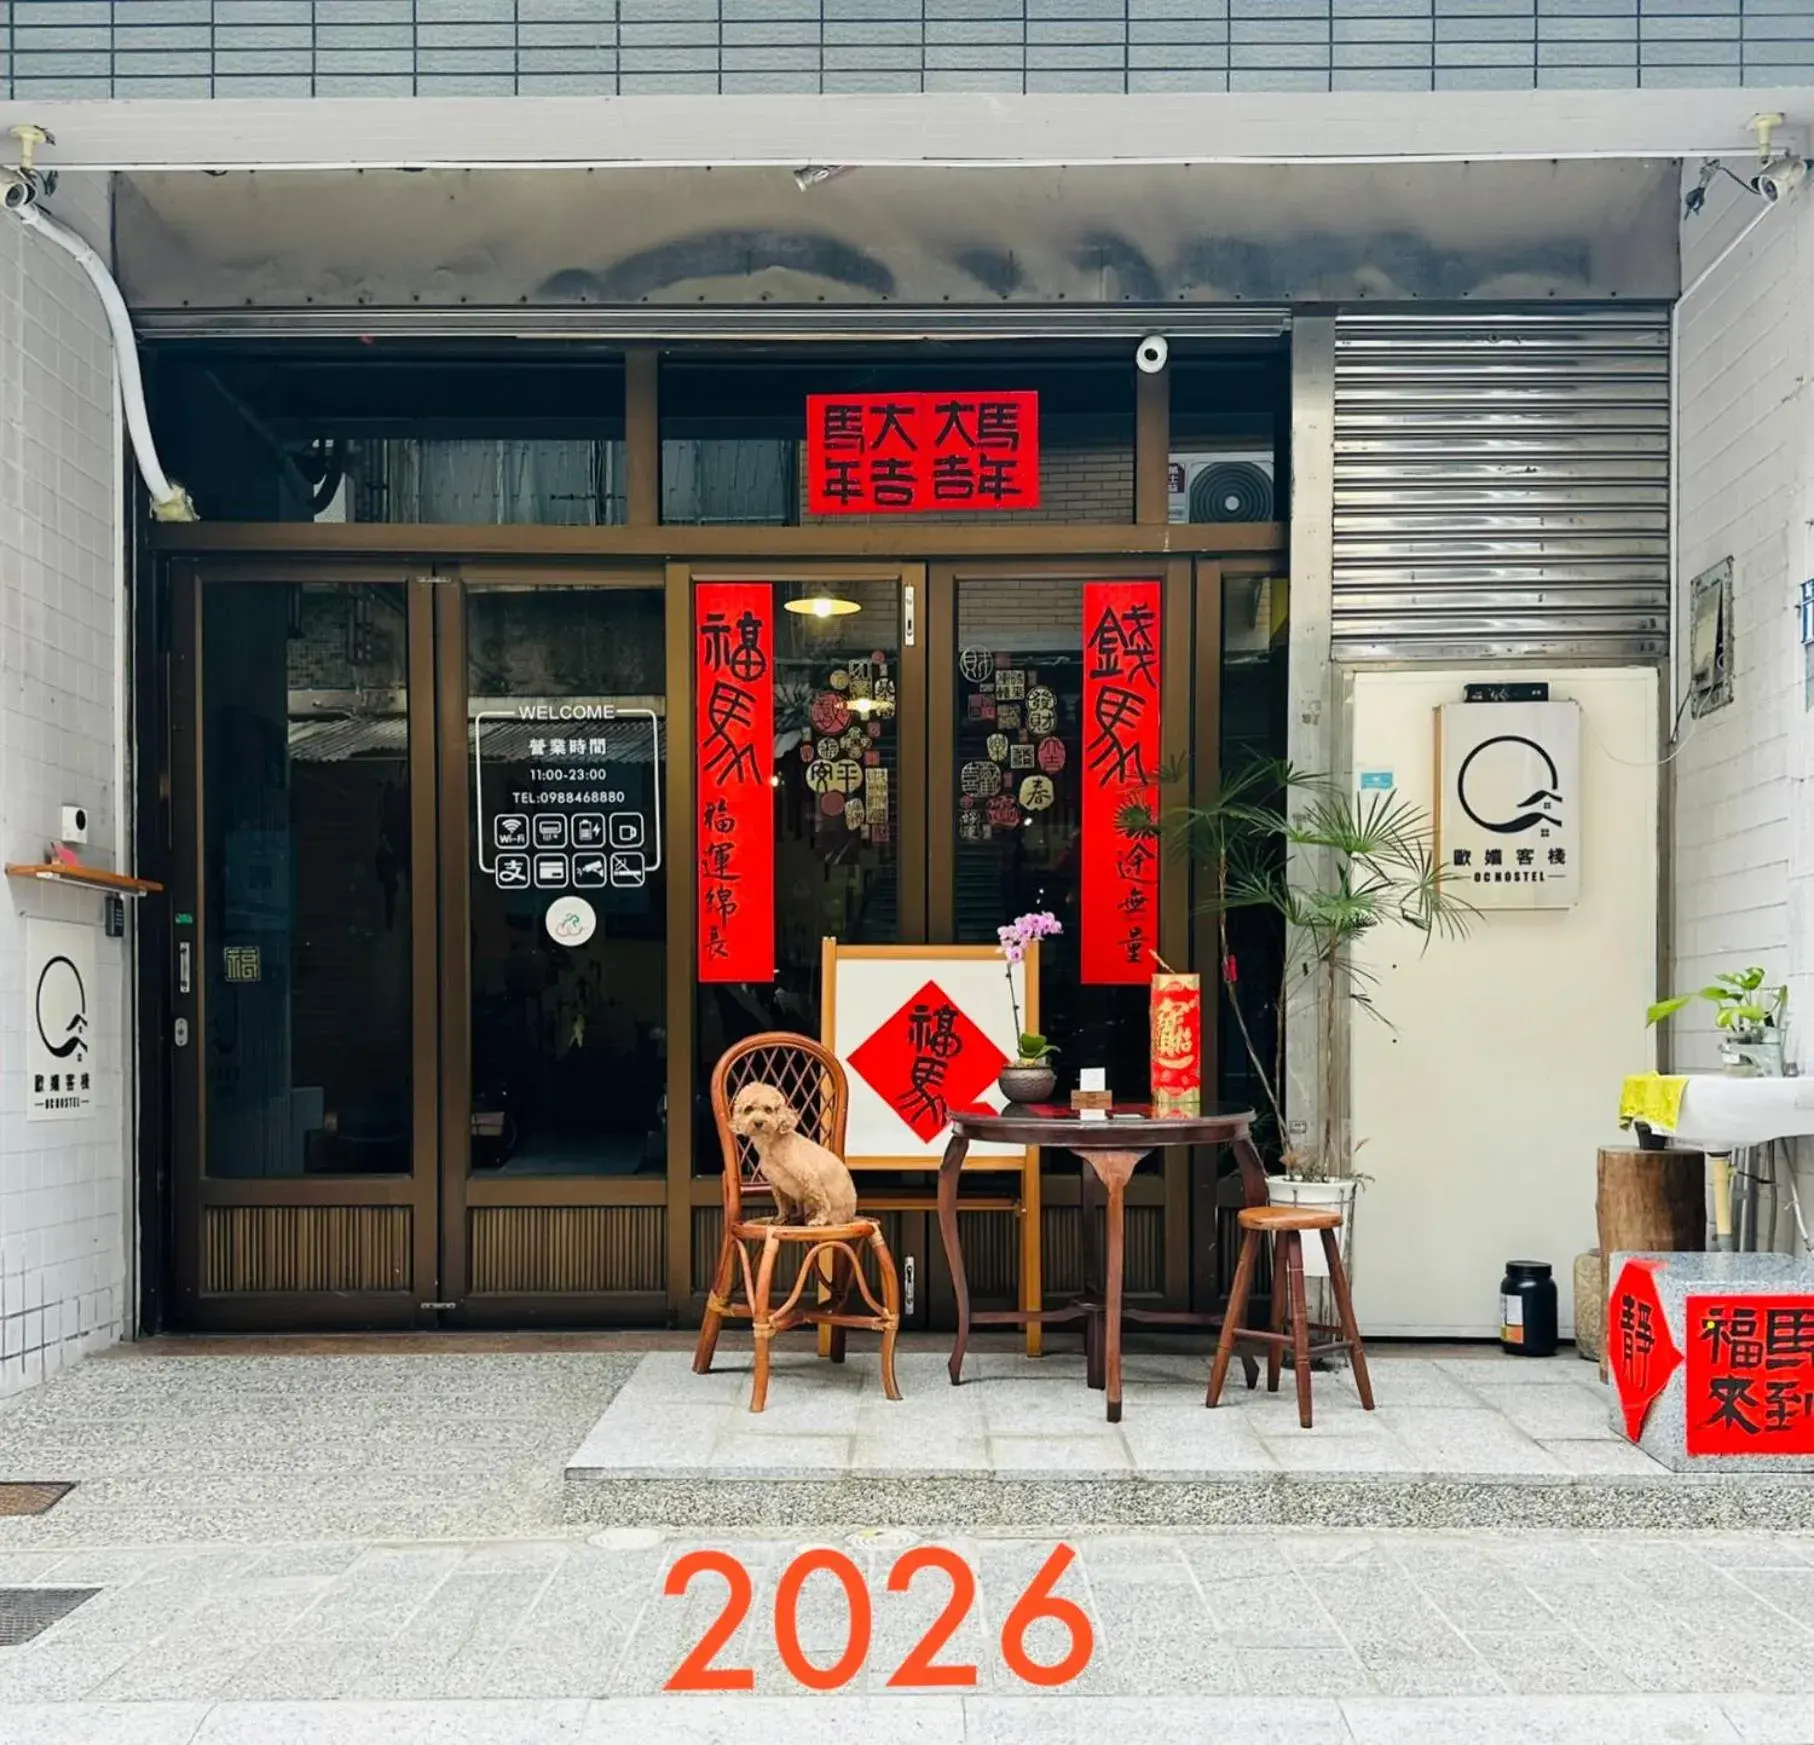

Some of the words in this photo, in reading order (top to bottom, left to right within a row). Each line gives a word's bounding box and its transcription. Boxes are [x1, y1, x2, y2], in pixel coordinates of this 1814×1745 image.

[518, 705, 615, 720] WELCOME
[528, 738, 607, 756] 營業時間
[530, 769, 607, 781] 11:00-23:00
[512, 791, 625, 804] TEL:0988468880
[1116, 800, 1158, 964] 途無量
